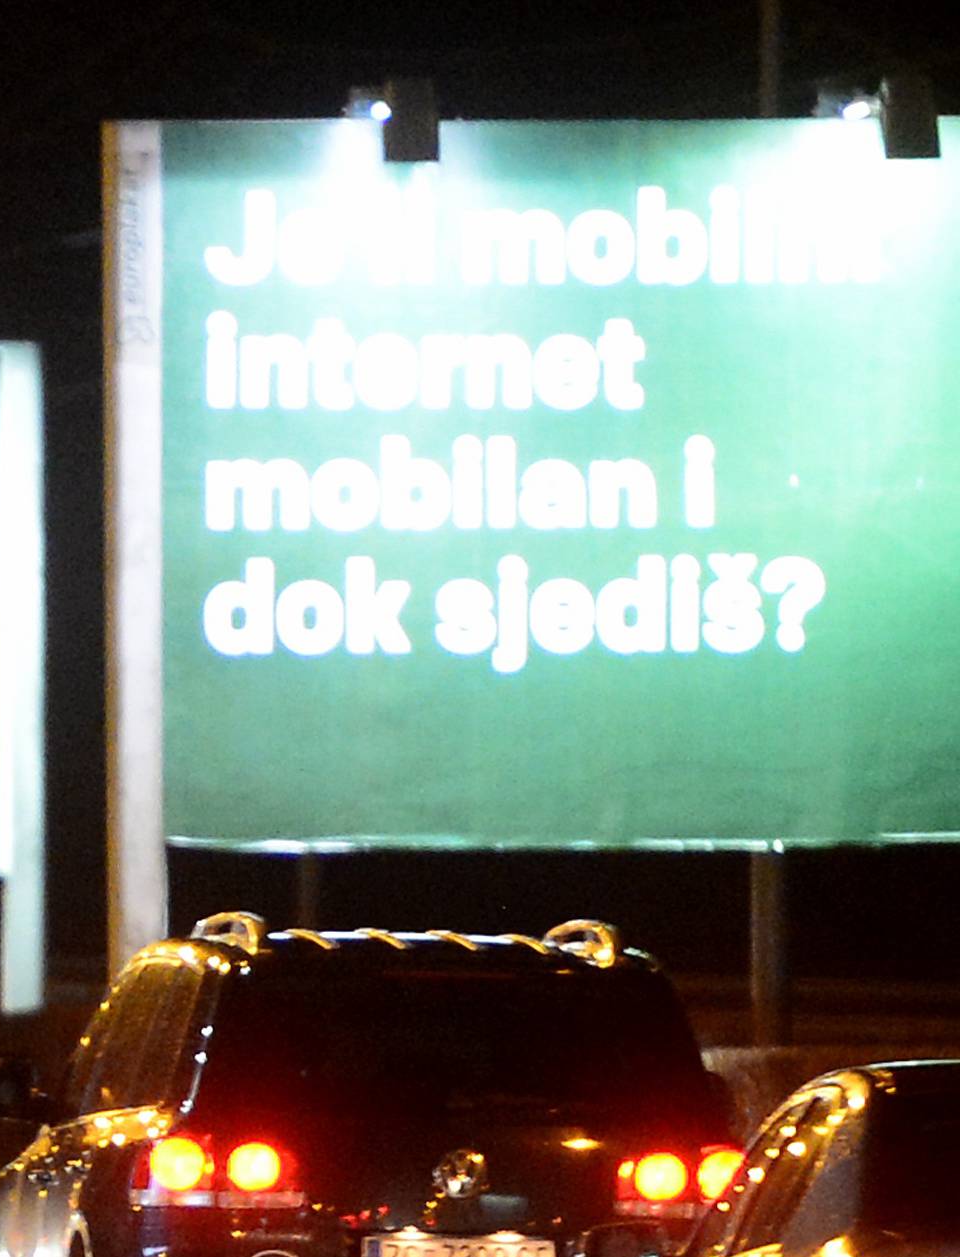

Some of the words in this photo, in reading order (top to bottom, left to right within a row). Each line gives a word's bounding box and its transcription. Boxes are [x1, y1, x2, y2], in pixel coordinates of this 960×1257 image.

[204, 311, 646, 412] internet
[204, 434, 657, 531] mobilan
[683, 434, 715, 528] i
[203, 557, 411, 656] dok
[435, 553, 827, 674] sjediš?
